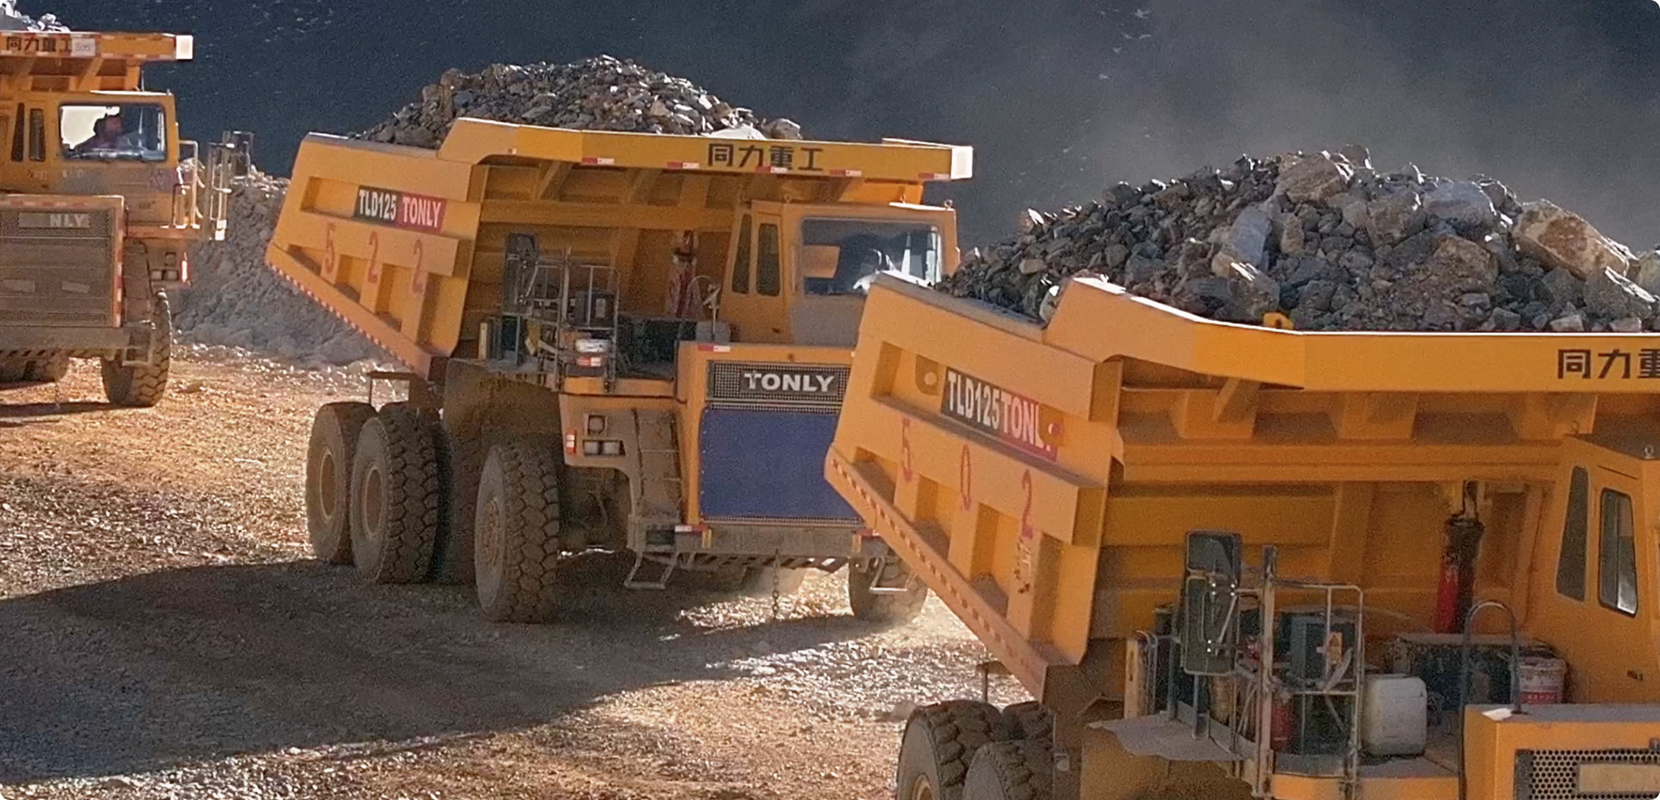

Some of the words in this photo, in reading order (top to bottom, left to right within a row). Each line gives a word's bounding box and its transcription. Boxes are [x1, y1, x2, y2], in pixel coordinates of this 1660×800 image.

[708, 143, 824, 172] 同力重工
[358, 189, 397, 221] TLD125
[402, 196, 441, 228] TONLY
[744, 371, 835, 393] TONLY
[947, 370, 1000, 430] TLD125
[1001, 391, 1051, 452] TONL
